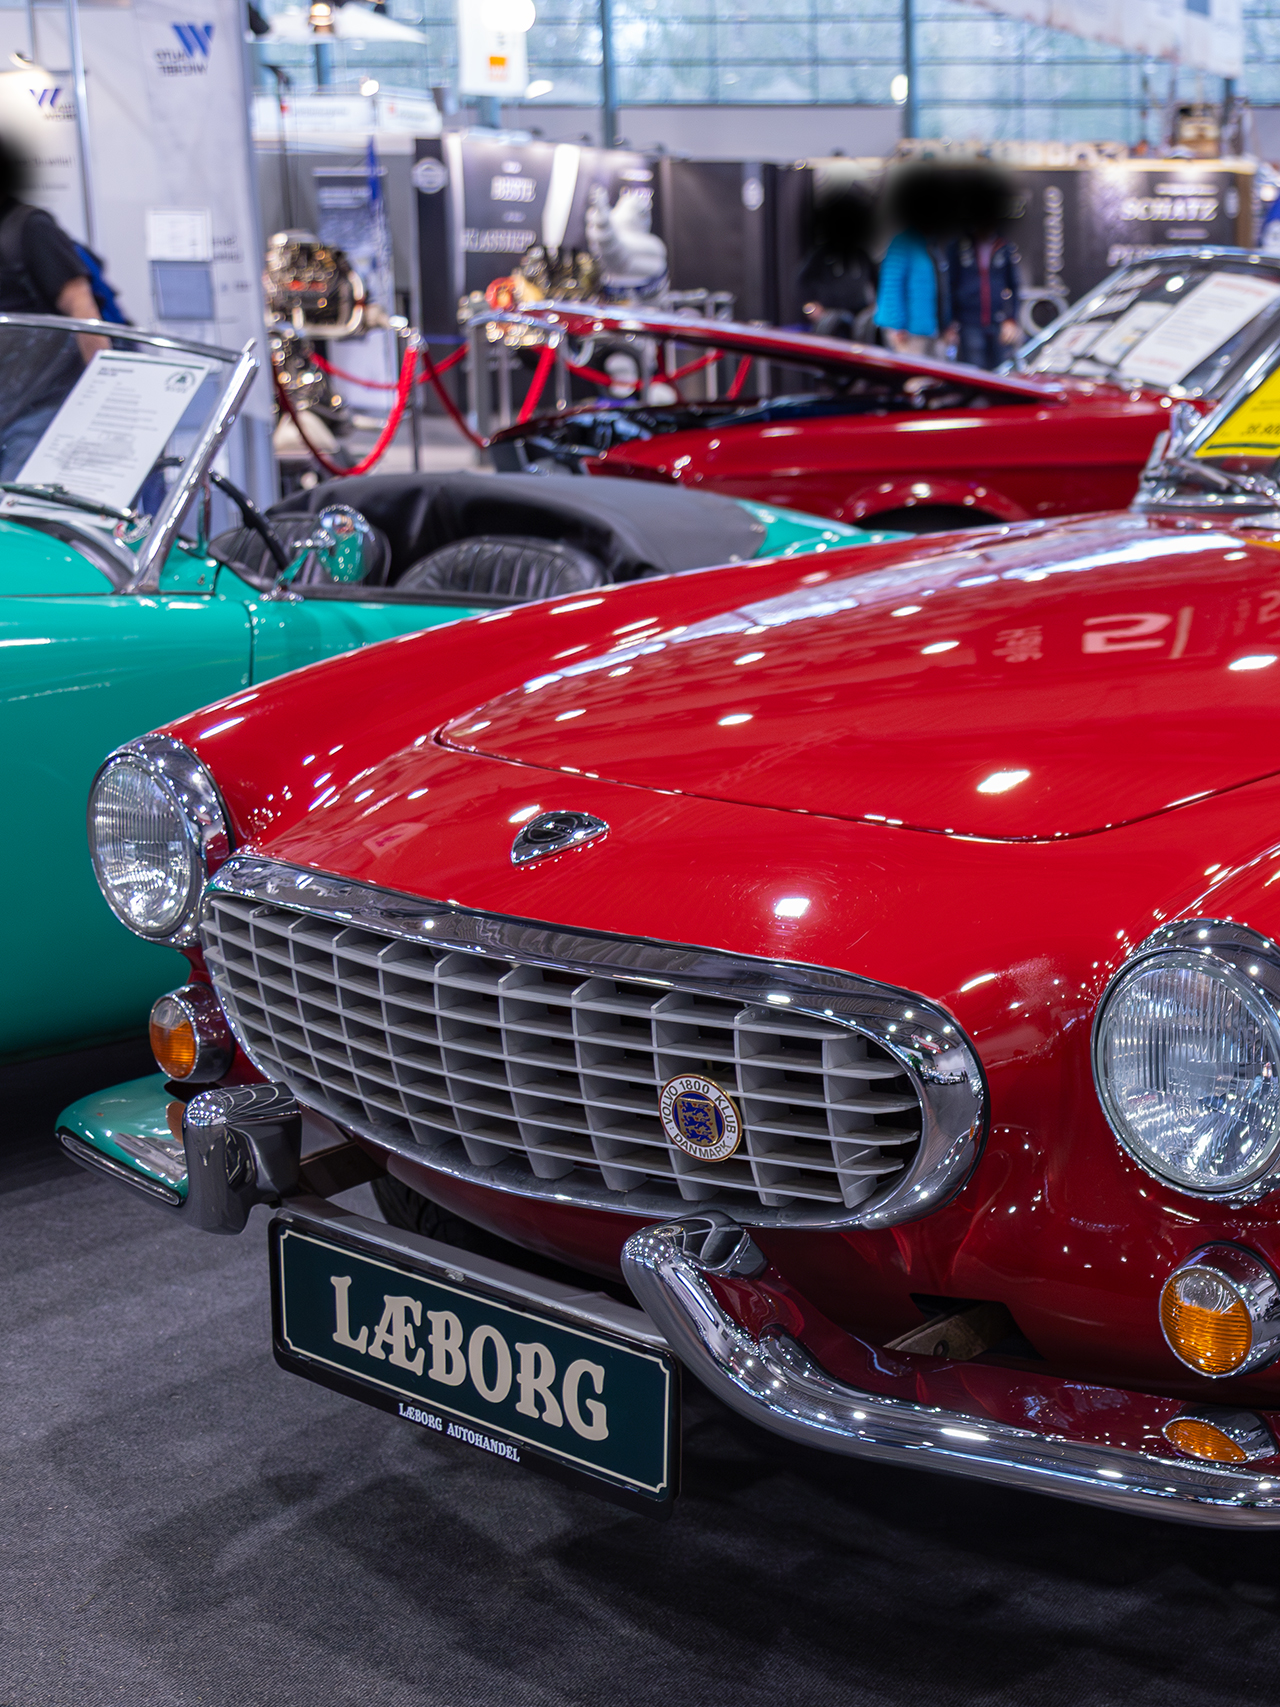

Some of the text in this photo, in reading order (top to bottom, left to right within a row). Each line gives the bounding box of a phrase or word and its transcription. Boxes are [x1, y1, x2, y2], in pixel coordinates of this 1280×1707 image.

[662, 1079, 736, 1134] VOLVO 1800 KLUB
[673, 1132, 731, 1158] DANMARK
[330, 1275, 610, 1441] LÆBORG
[398, 1403, 521, 1463] LÆBORG AUTOHANDEL
